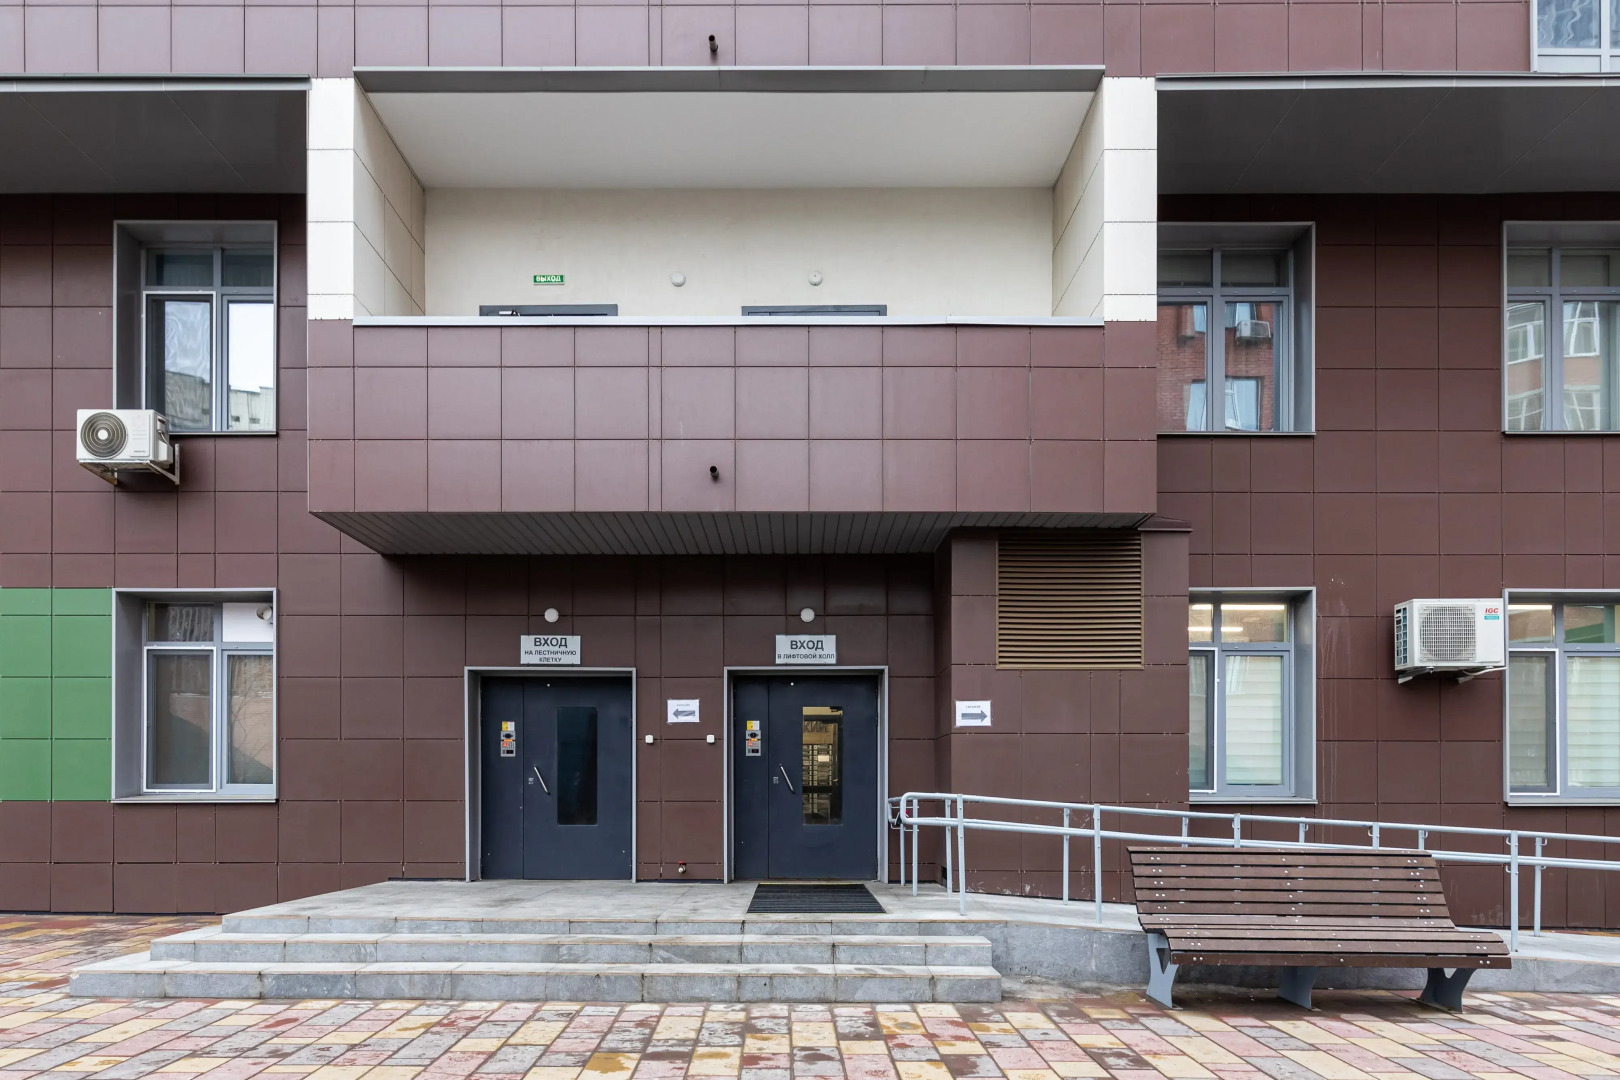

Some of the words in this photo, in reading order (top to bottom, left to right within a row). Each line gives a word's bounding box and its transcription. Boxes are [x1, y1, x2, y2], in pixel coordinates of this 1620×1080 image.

[533, 637, 568, 649] ВХОД
[790, 640, 824, 651] ВХОД
[783, 652, 817, 660] ЛИФТОВОЙ
